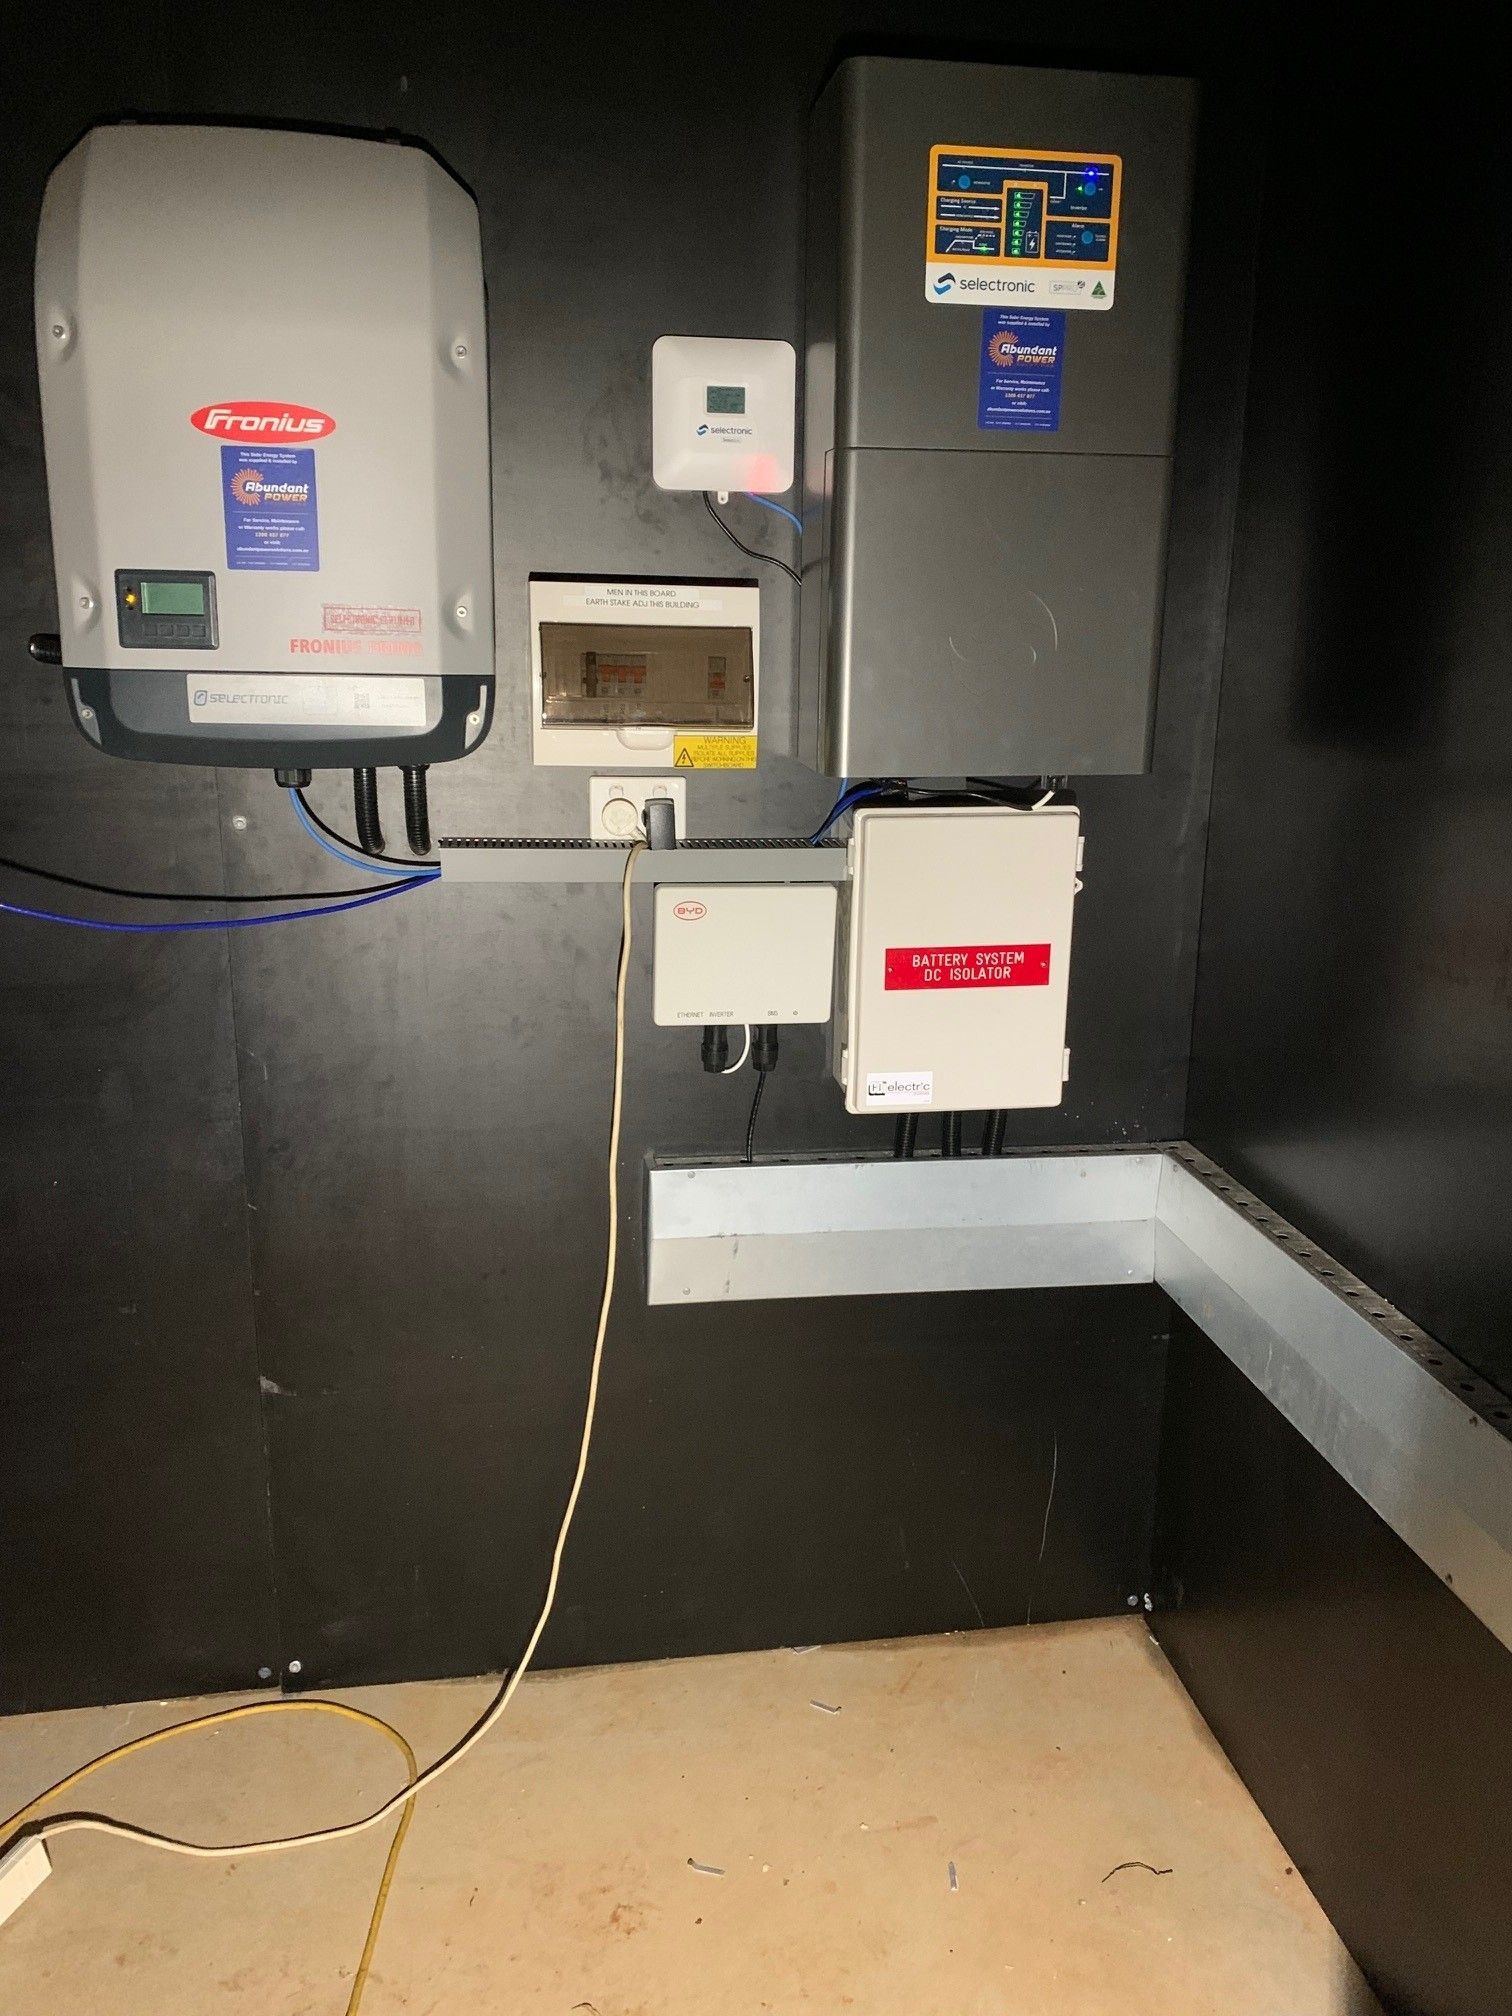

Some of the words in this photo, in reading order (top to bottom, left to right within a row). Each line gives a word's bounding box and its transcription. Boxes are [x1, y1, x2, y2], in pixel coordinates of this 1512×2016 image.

[960, 277, 1035, 293] selectronic
[1001, 344, 1058, 356] Abundant
[1017, 355, 1056, 364] POWER
[204, 408, 326, 433] Fronius
[710, 426, 752, 435] selectronic
[246, 482, 309, 493] Abundant
[264, 493, 307, 502] POWER
[585, 598, 608, 606] EARTH
[610, 599, 631, 607] STAKE
[704, 736, 747, 745] WARNING
[677, 907, 703, 915] BYD
[912, 953, 968, 968] BATTERY
[976, 952, 1024, 966] SYSTEM
[924, 969, 942, 982] DC
[950, 967, 1011, 981] ISOLATOR
